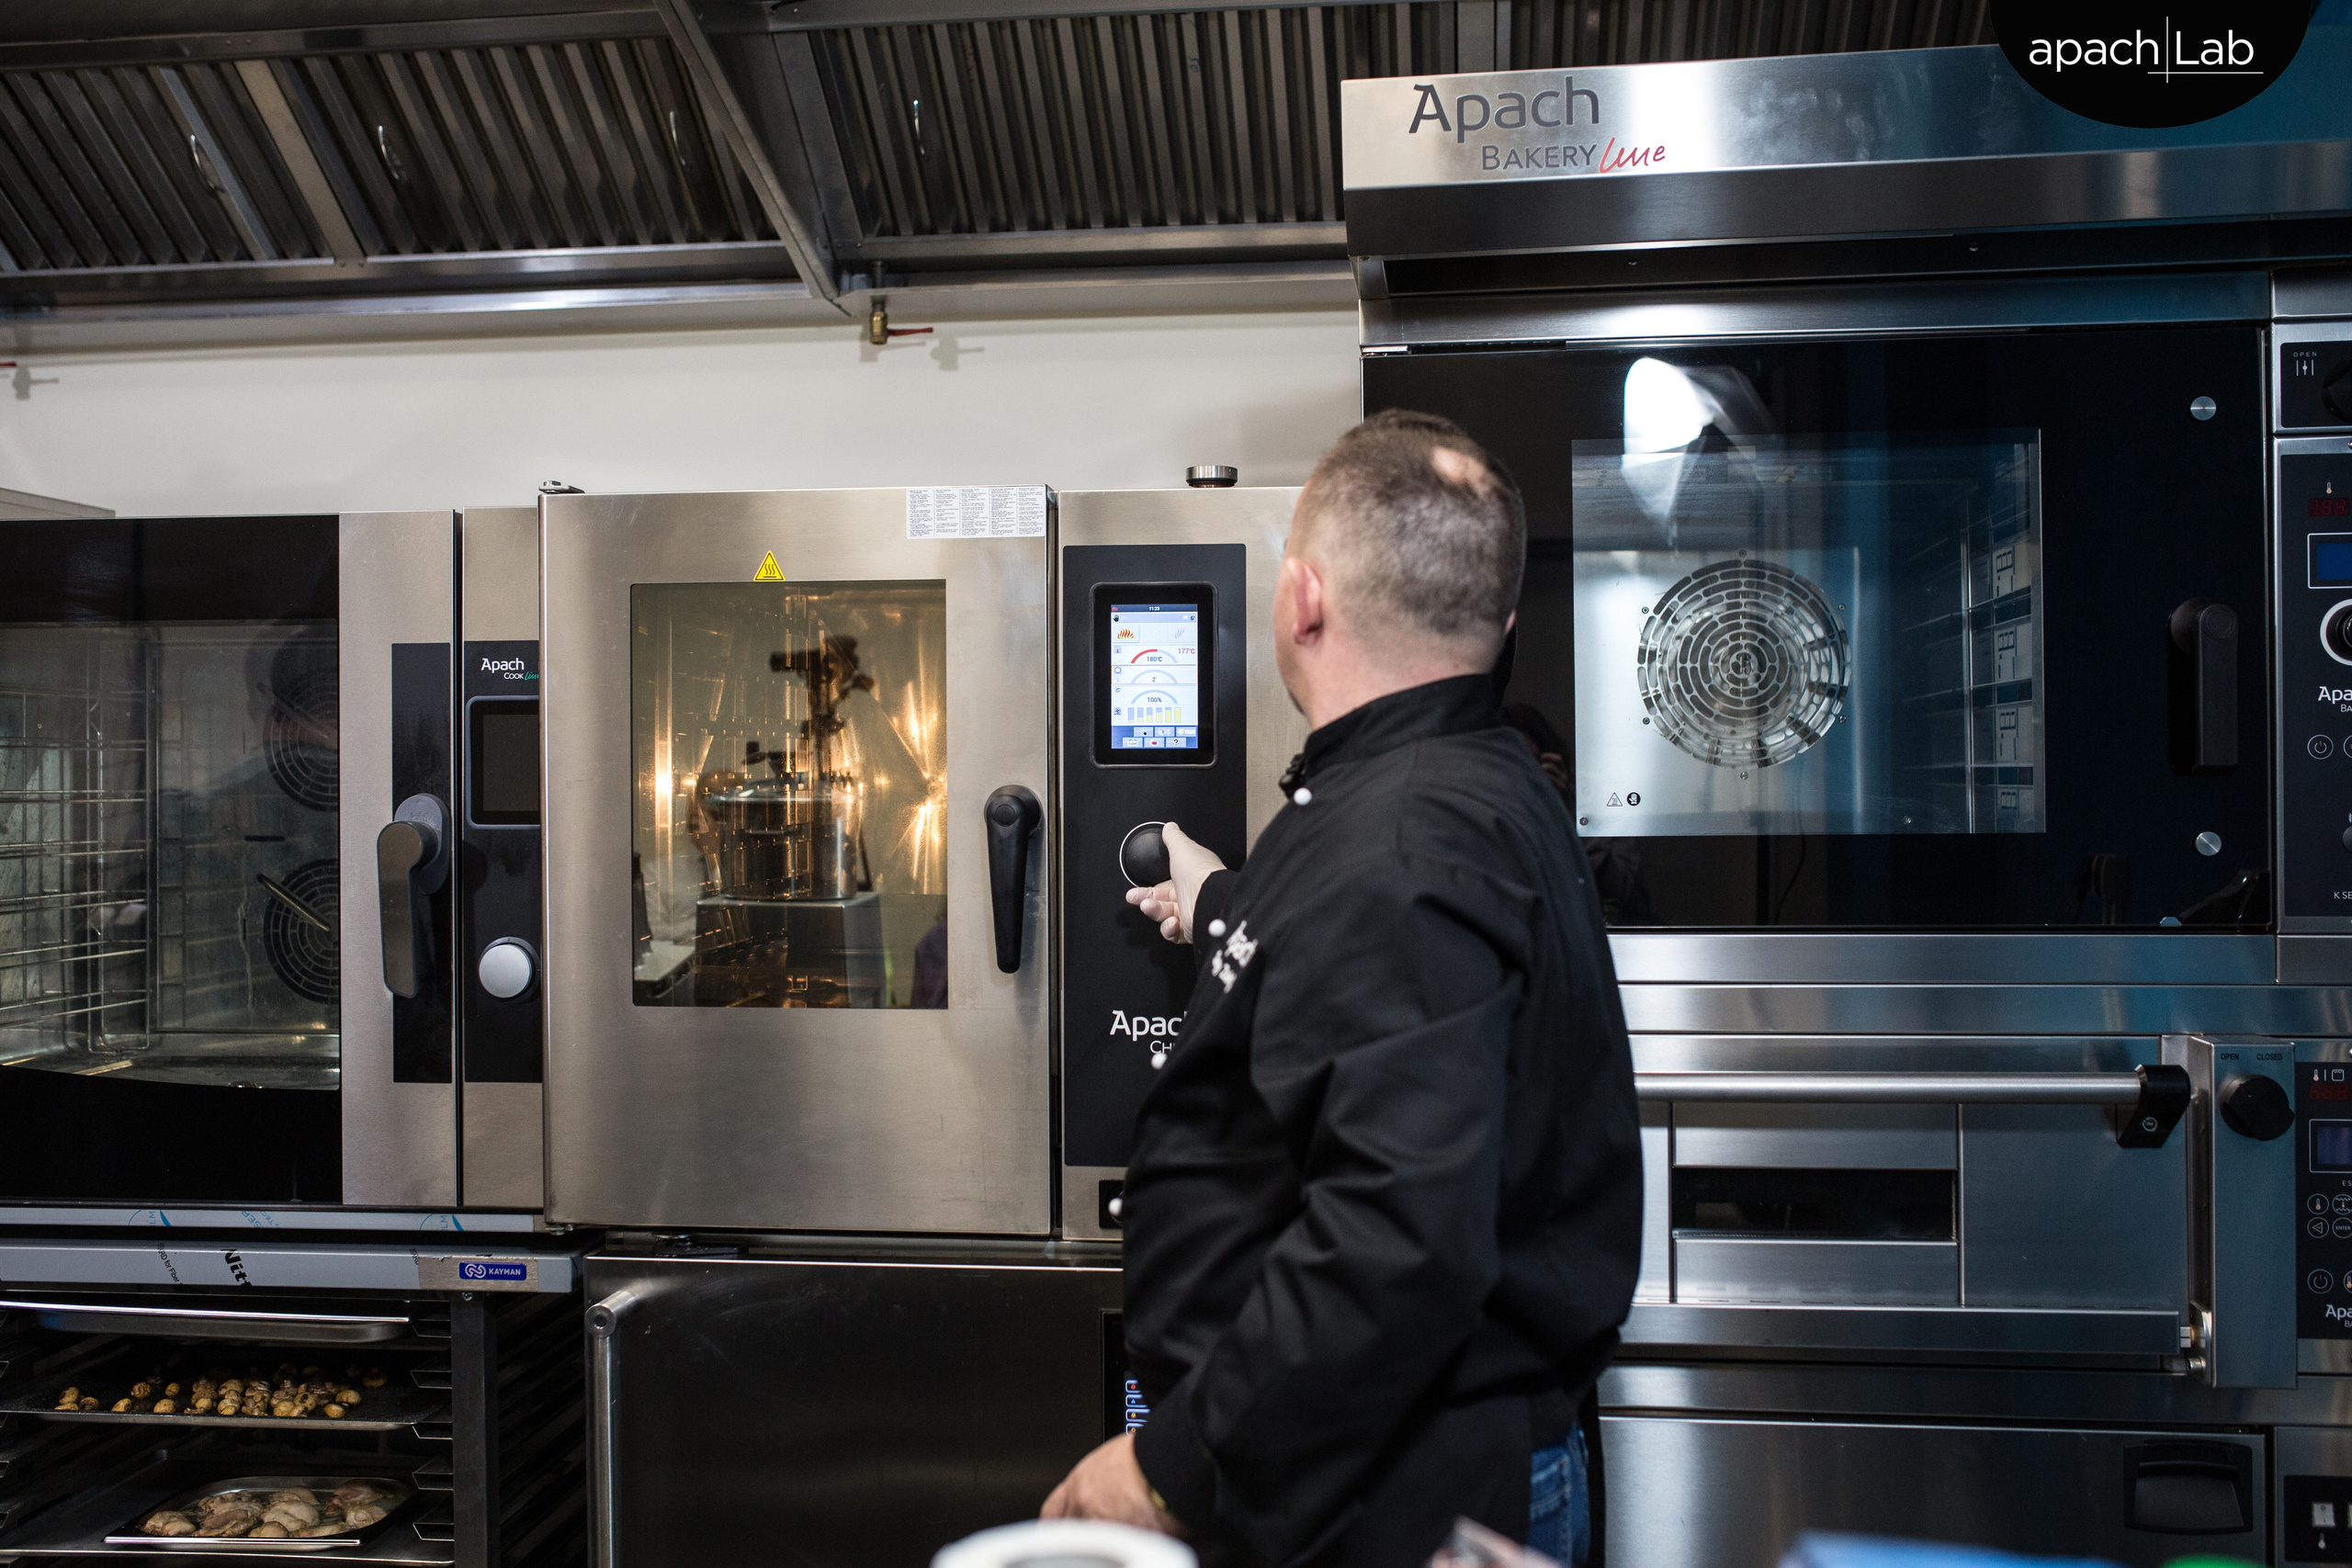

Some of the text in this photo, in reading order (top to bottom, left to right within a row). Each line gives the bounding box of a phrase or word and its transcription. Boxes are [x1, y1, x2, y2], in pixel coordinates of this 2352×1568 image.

[1408, 75, 1600, 143] Apach
[1481, 143, 1598, 171] BAKERY
[481, 657, 525, 673] Apach
[2334, 891, 2340, 899] K
[1109, 1010, 1187, 1042] Apac
[1149, 1040, 1175, 1054] CH
[2256, 1053, 2282, 1061] CLOSED
[488, 1268, 521, 1276] KAYMAN
